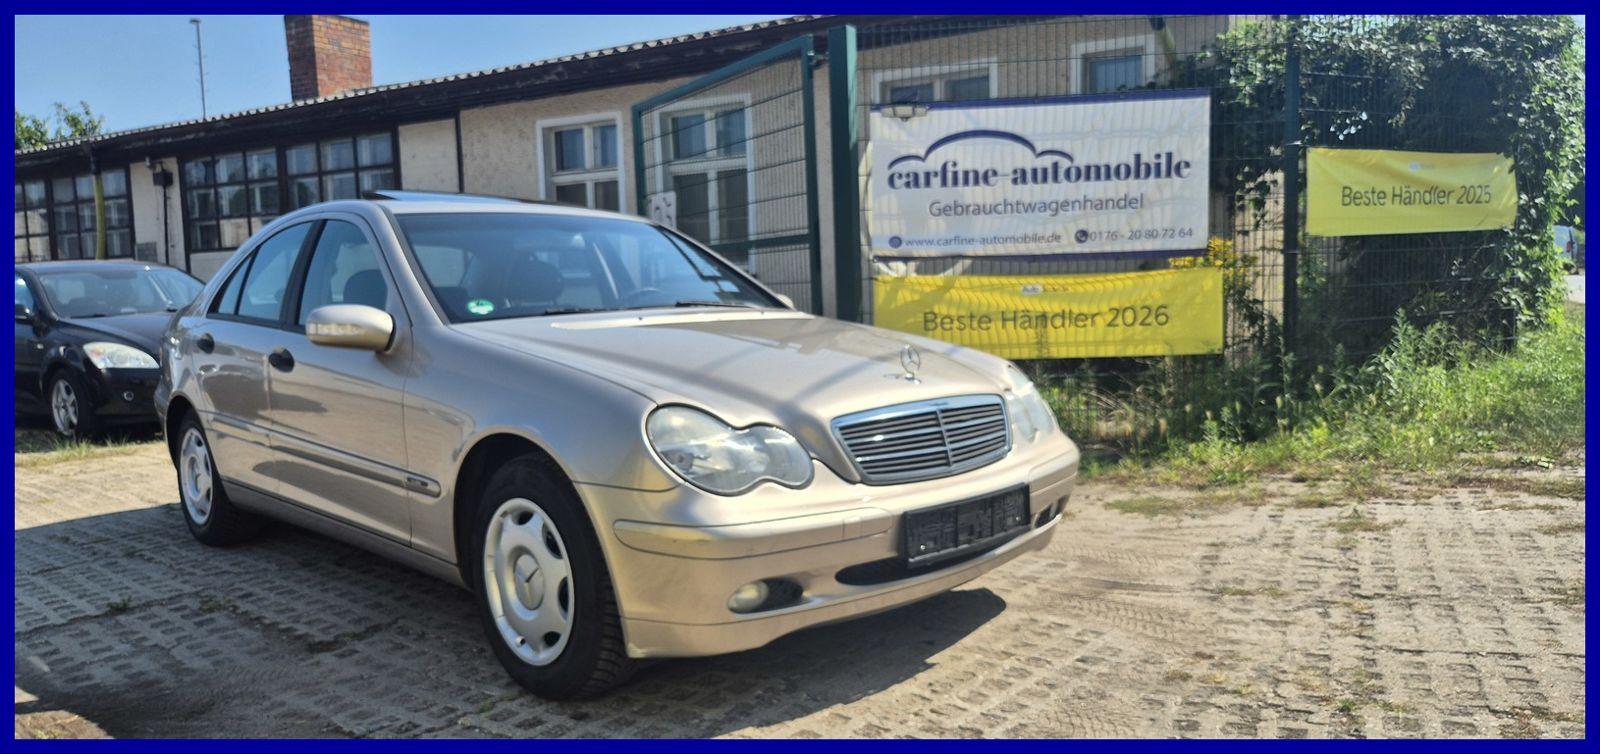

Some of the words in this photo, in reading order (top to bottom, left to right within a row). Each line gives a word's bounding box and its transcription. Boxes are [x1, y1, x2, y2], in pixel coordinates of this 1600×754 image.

[887, 152, 1191, 189] carfine-automobile
[928, 193, 1143, 217] Gebrauchtwagenhandel
[1341, 187, 1387, 206] Beste
[1392, 186, 1454, 205] Händler
[1457, 185, 1492, 203] 2025
[905, 233, 1061, 248] www.carfine-automobile.de
[923, 311, 992, 331] Beste
[1001, 308, 1099, 329] Händler
[1107, 305, 1170, 327] 2026
